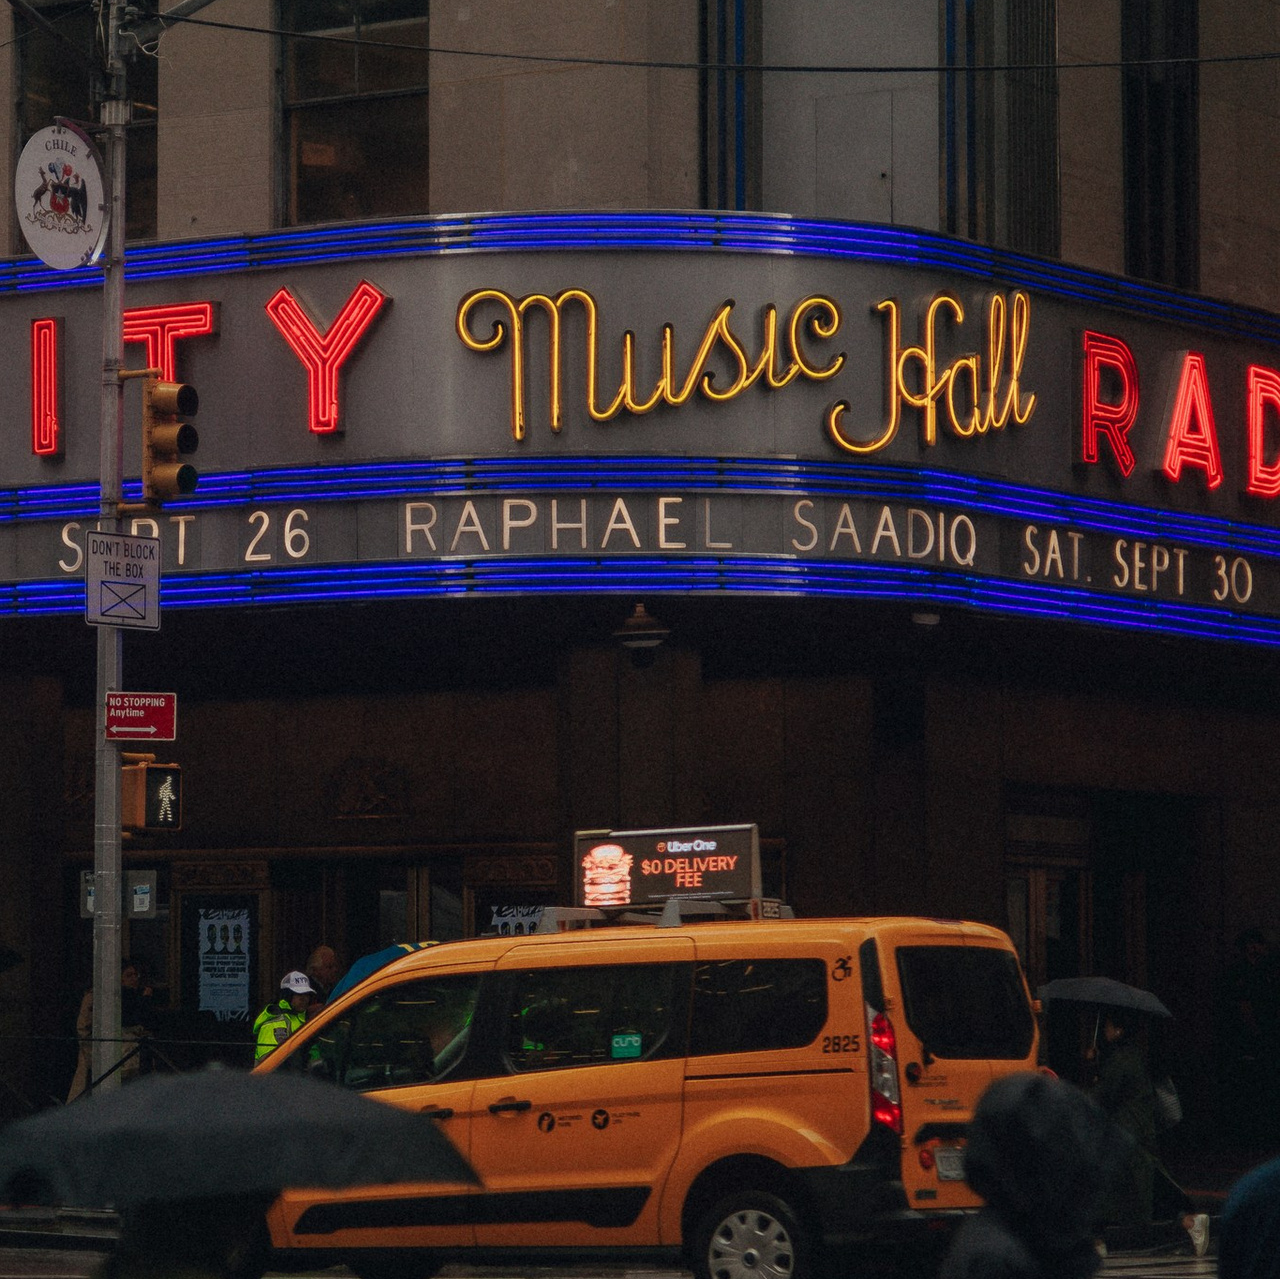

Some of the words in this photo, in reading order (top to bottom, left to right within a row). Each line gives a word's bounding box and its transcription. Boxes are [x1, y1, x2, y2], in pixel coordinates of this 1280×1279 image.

[45, 139, 78, 157] CHILE
[455, 287, 847, 442] Music
[825, 289, 1036, 453] Hall
[244, 508, 312, 562] 26
[91, 539, 120, 557] DON'T
[123, 542, 156, 561] BLOCK
[404, 496, 733, 554] RAPHAEL
[790, 498, 978, 567] SAADIQ
[1022, 524, 1093, 583] SAT.
[1112, 538, 1189, 595] SEPT
[1212, 555, 1254, 604] 30
[103, 560, 122, 577] THE
[124, 563, 144, 579] BOX
[109, 696, 122, 707] NO
[123, 697, 166, 708] STOPPING
[109, 707, 145, 719] Anytime
[641, 858, 662, 875] $0
[664, 855, 738, 874] DELIVERY
[675, 872, 703, 888] FEE
